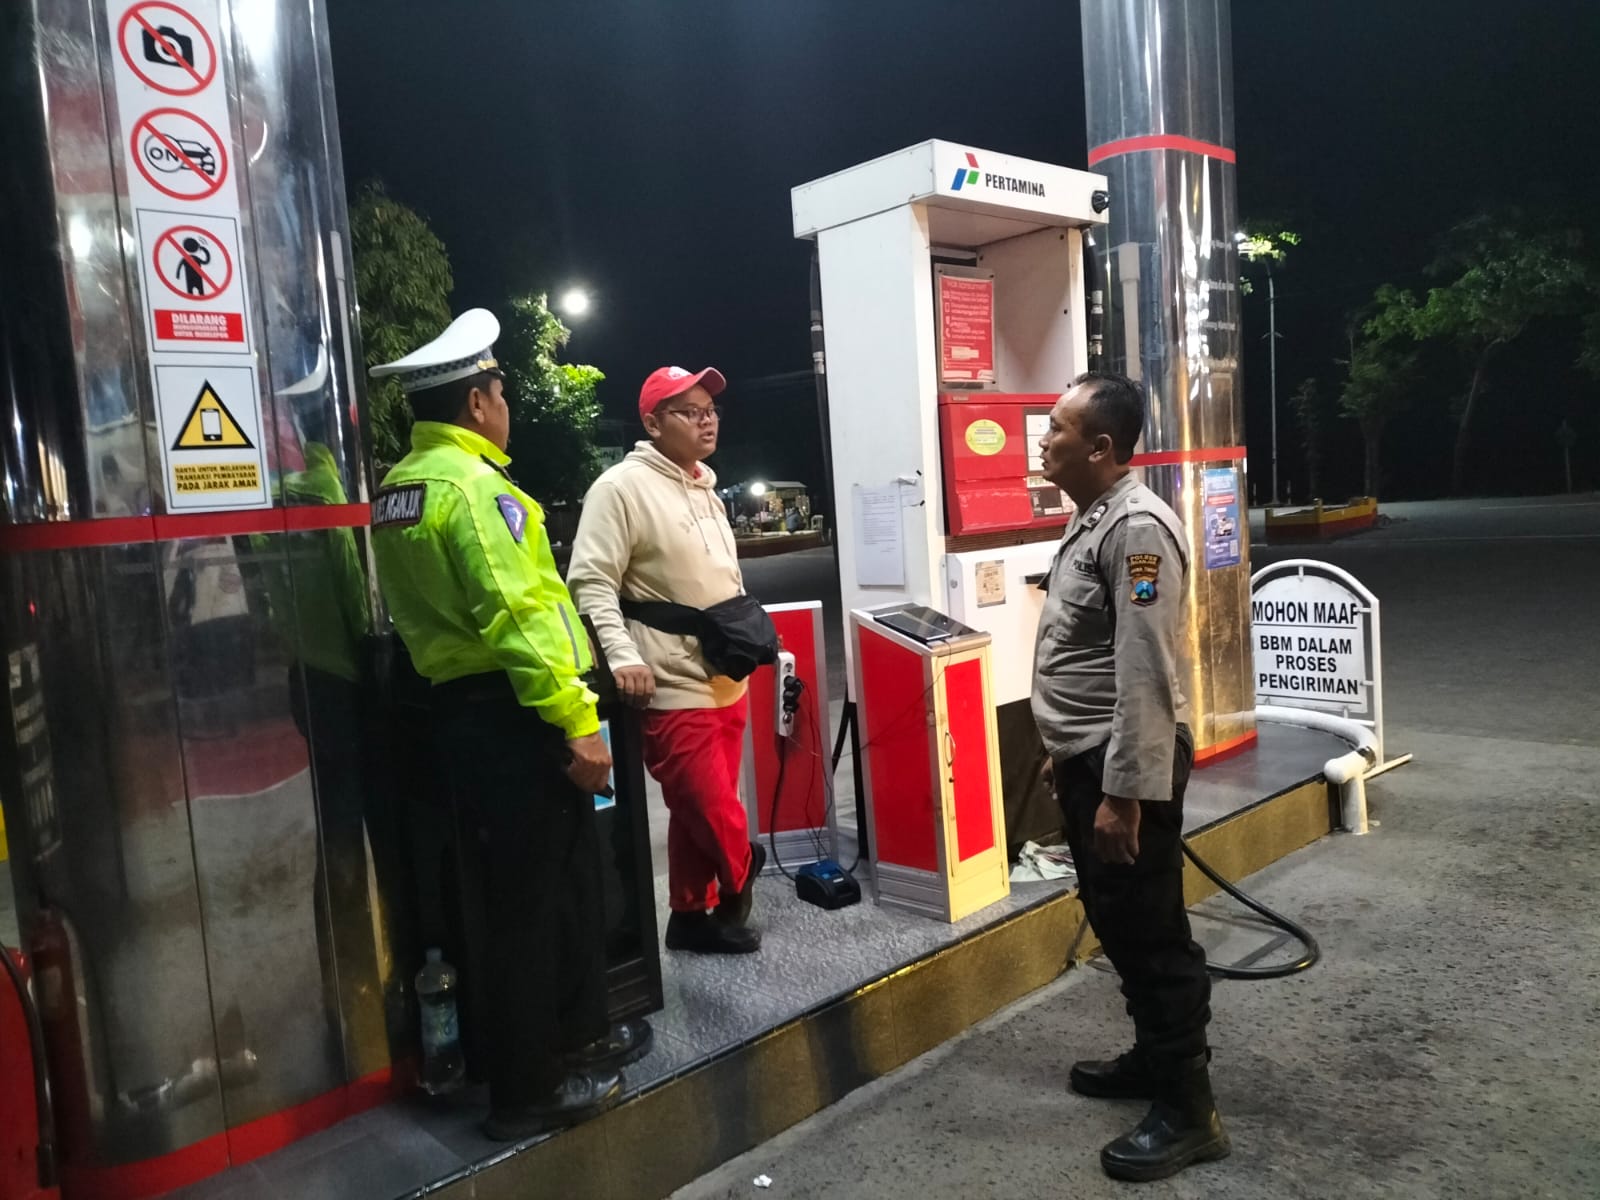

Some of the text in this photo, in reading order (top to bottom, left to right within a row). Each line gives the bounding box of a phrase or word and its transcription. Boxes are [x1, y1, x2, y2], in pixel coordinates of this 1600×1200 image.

[150, 146, 182, 162] ON
[985, 173, 1046, 197] PERTAMINA
[171, 313, 227, 326] DILARANG
[176, 471, 256, 481] TRANSAKSI PEMBAYARAN
[220, 464, 256, 472] MELAKUKAN
[177, 479, 258, 491] PADA JARAK AMAN
[1252, 601, 1358, 624] MOHON MAAF
[1260, 635, 1352, 654] BBM DALAM
[1276, 654, 1337, 673] PROSES
[1259, 673, 1359, 695] PENGIRIMAN
